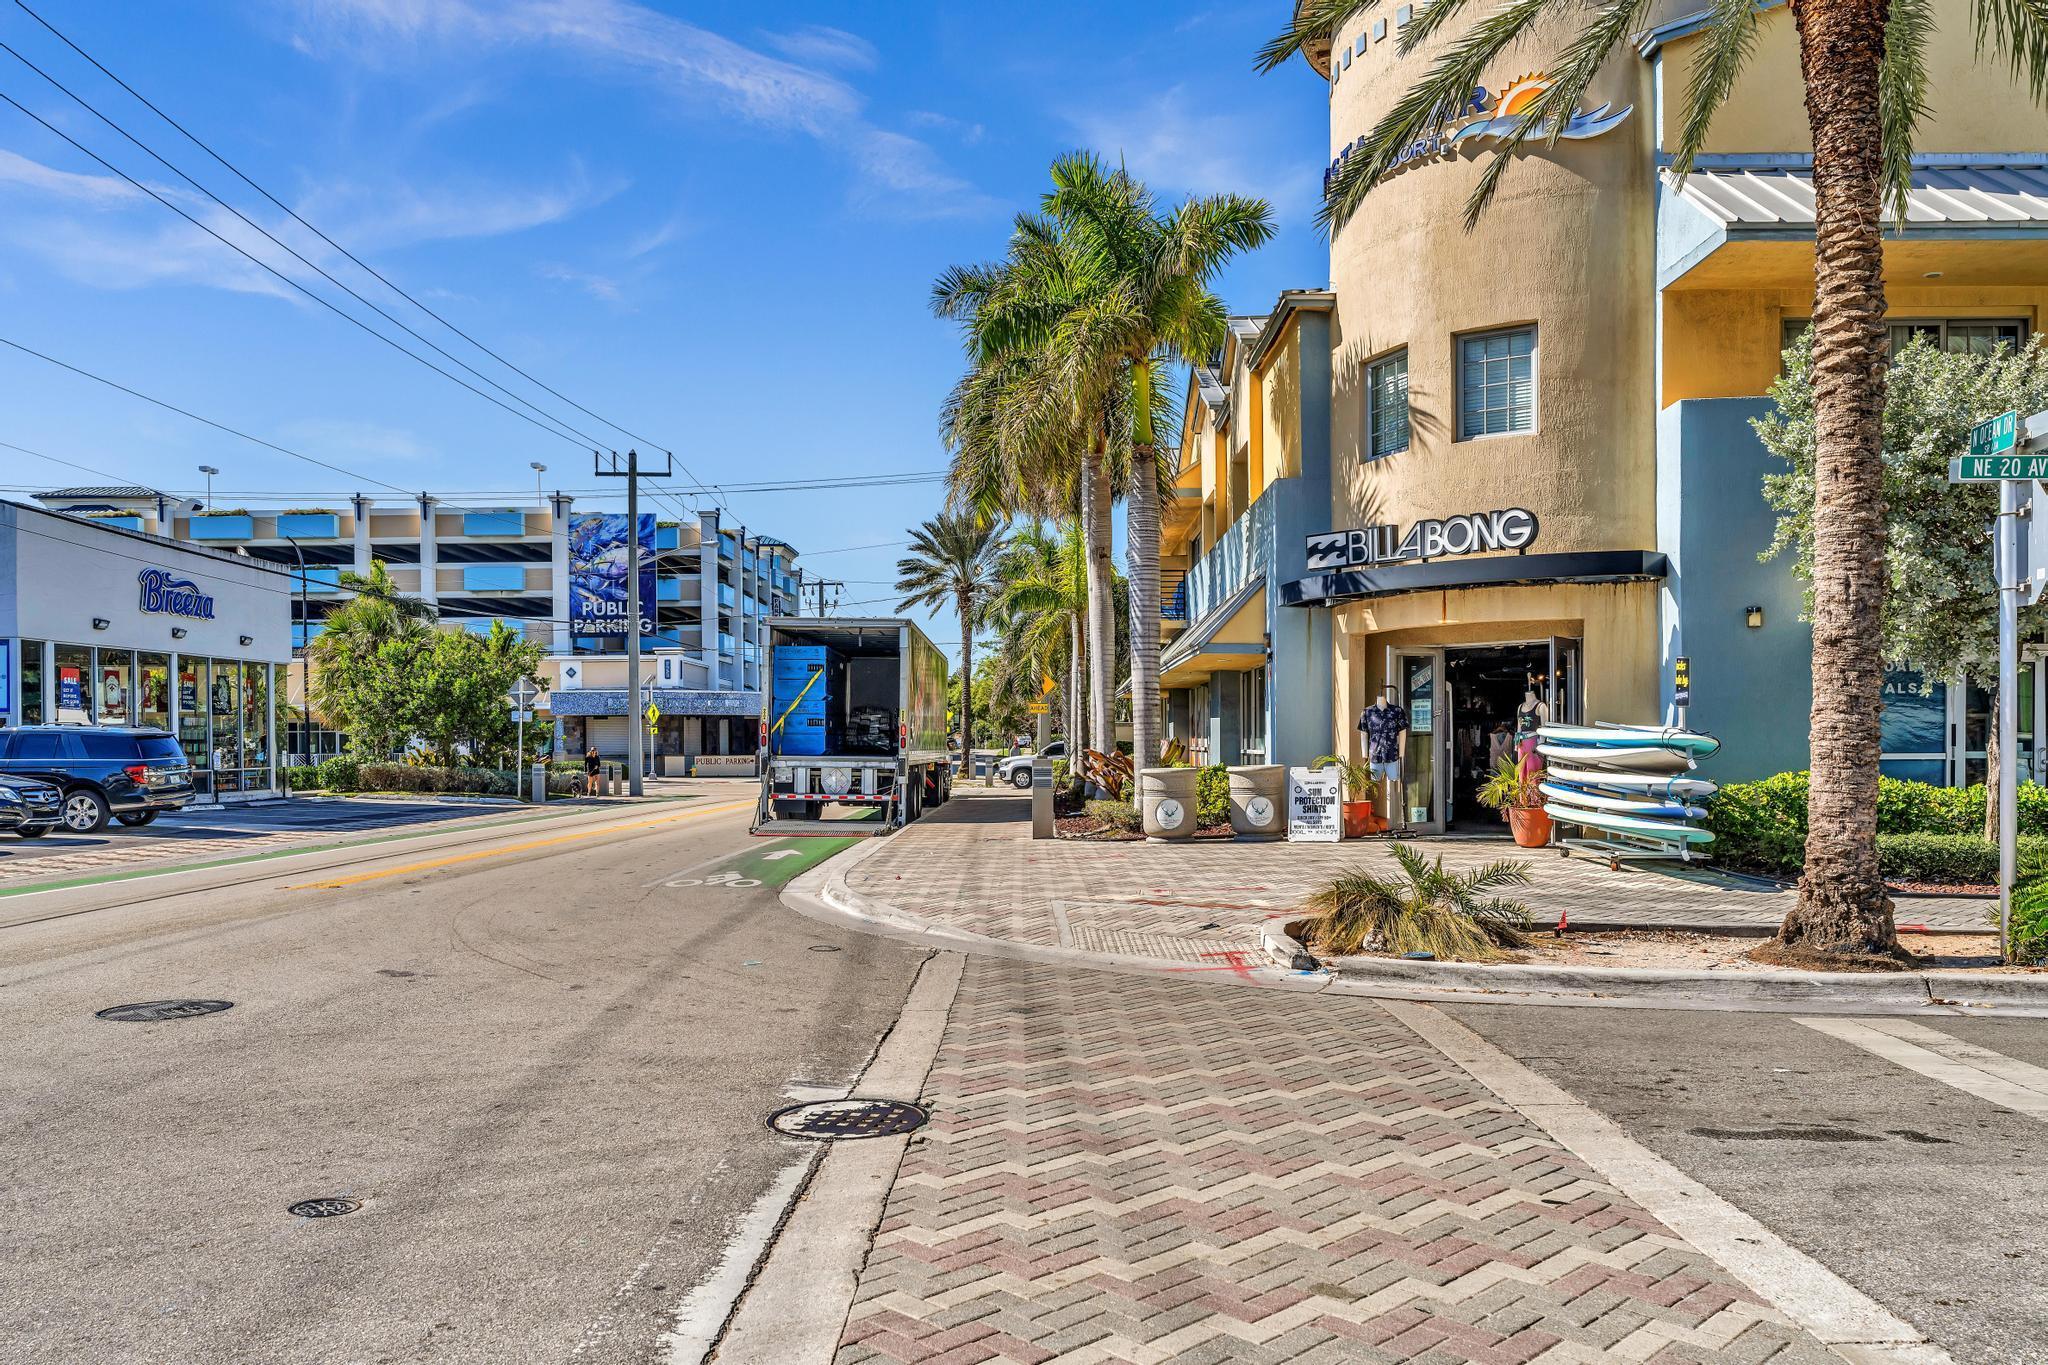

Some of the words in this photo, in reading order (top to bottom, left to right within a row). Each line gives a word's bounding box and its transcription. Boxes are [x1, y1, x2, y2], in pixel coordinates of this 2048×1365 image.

[1972, 429, 1978, 448] N
[1980, 420, 2001, 445] OCEAN
[2003, 415, 2013, 435] DR
[1973, 459, 1993, 477] NE
[2000, 458, 2021, 477] 20
[2028, 458, 2047, 477] AV
[1348, 508, 1536, 564] BILLABONG
[140, 568, 215, 619] Breeza
[582, 601, 644, 616] PUBLC
[574, 618, 652, 633] PARKIG
[696, 757, 721, 765] PUBLIC
[725, 757, 751, 765] PARKING
[1308, 788, 1322, 796] SUN
[1295, 796, 1335, 805] PROTECTION
[1302, 805, 1326, 813] SHIRTS
